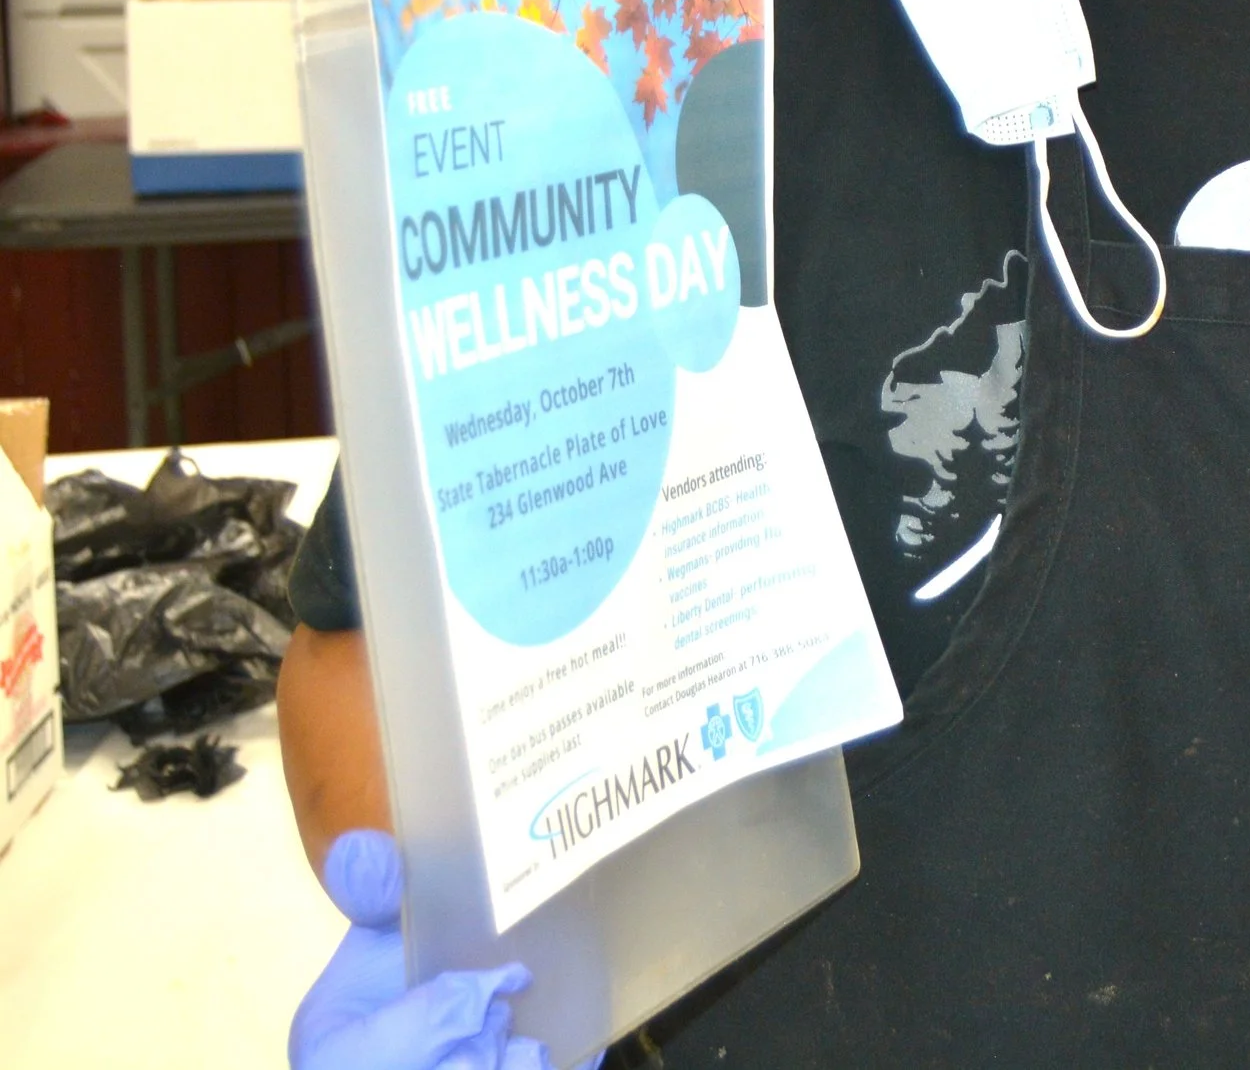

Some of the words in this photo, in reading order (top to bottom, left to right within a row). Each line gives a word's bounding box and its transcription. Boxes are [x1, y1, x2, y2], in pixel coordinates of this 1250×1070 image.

[407, 85, 452, 115] FREE
[413, 120, 506, 178] EVENT
[401, 165, 641, 281] COMMUNITY
[410, 251, 639, 380] WELLNESS
[645, 224, 729, 310] DAY
[444, 400, 537, 449] Wednesday,
[540, 377, 604, 413] October
[608, 362, 635, 390] 7th
[437, 481, 473, 512] State
[476, 444, 561, 495] Tabernacle
[566, 427, 606, 460] Plate
[611, 418, 626, 443] of
[631, 409, 668, 437] Love
[662, 474, 707, 502] Vendors
[709, 452, 768, 485] attending:
[487, 500, 513, 529] 234
[517, 466, 594, 516] Glenwood
[599, 459, 628, 484] Ave
[661, 506, 704, 535] Highmark
[736, 482, 771, 504] Health
[664, 530, 706, 558] insurance
[709, 509, 766, 538] information
[715, 534, 760, 562] providing
[520, 536, 614, 591] 11:30a-1:00p
[669, 578, 708, 604] vaccines
[671, 604, 702, 628] Liberty
[674, 625, 702, 650] dental
[704, 604, 759, 637] screenings
[508, 683, 535, 707] enjoy
[538, 678, 544, 690] a
[546, 664, 567, 684] free
[570, 651, 589, 672] hot
[642, 685, 654, 700] For
[656, 674, 676, 692] more
[644, 694, 674, 718] Contact
[675, 679, 707, 703] Douglas
[707, 663, 737, 685] Hearon
[738, 660, 748, 673] at
[529, 729, 547, 749] bus
[549, 708, 583, 740] passes
[586, 679, 635, 716] available
[562, 733, 583, 755] last
[545, 731, 697, 860] HIGHMARK
